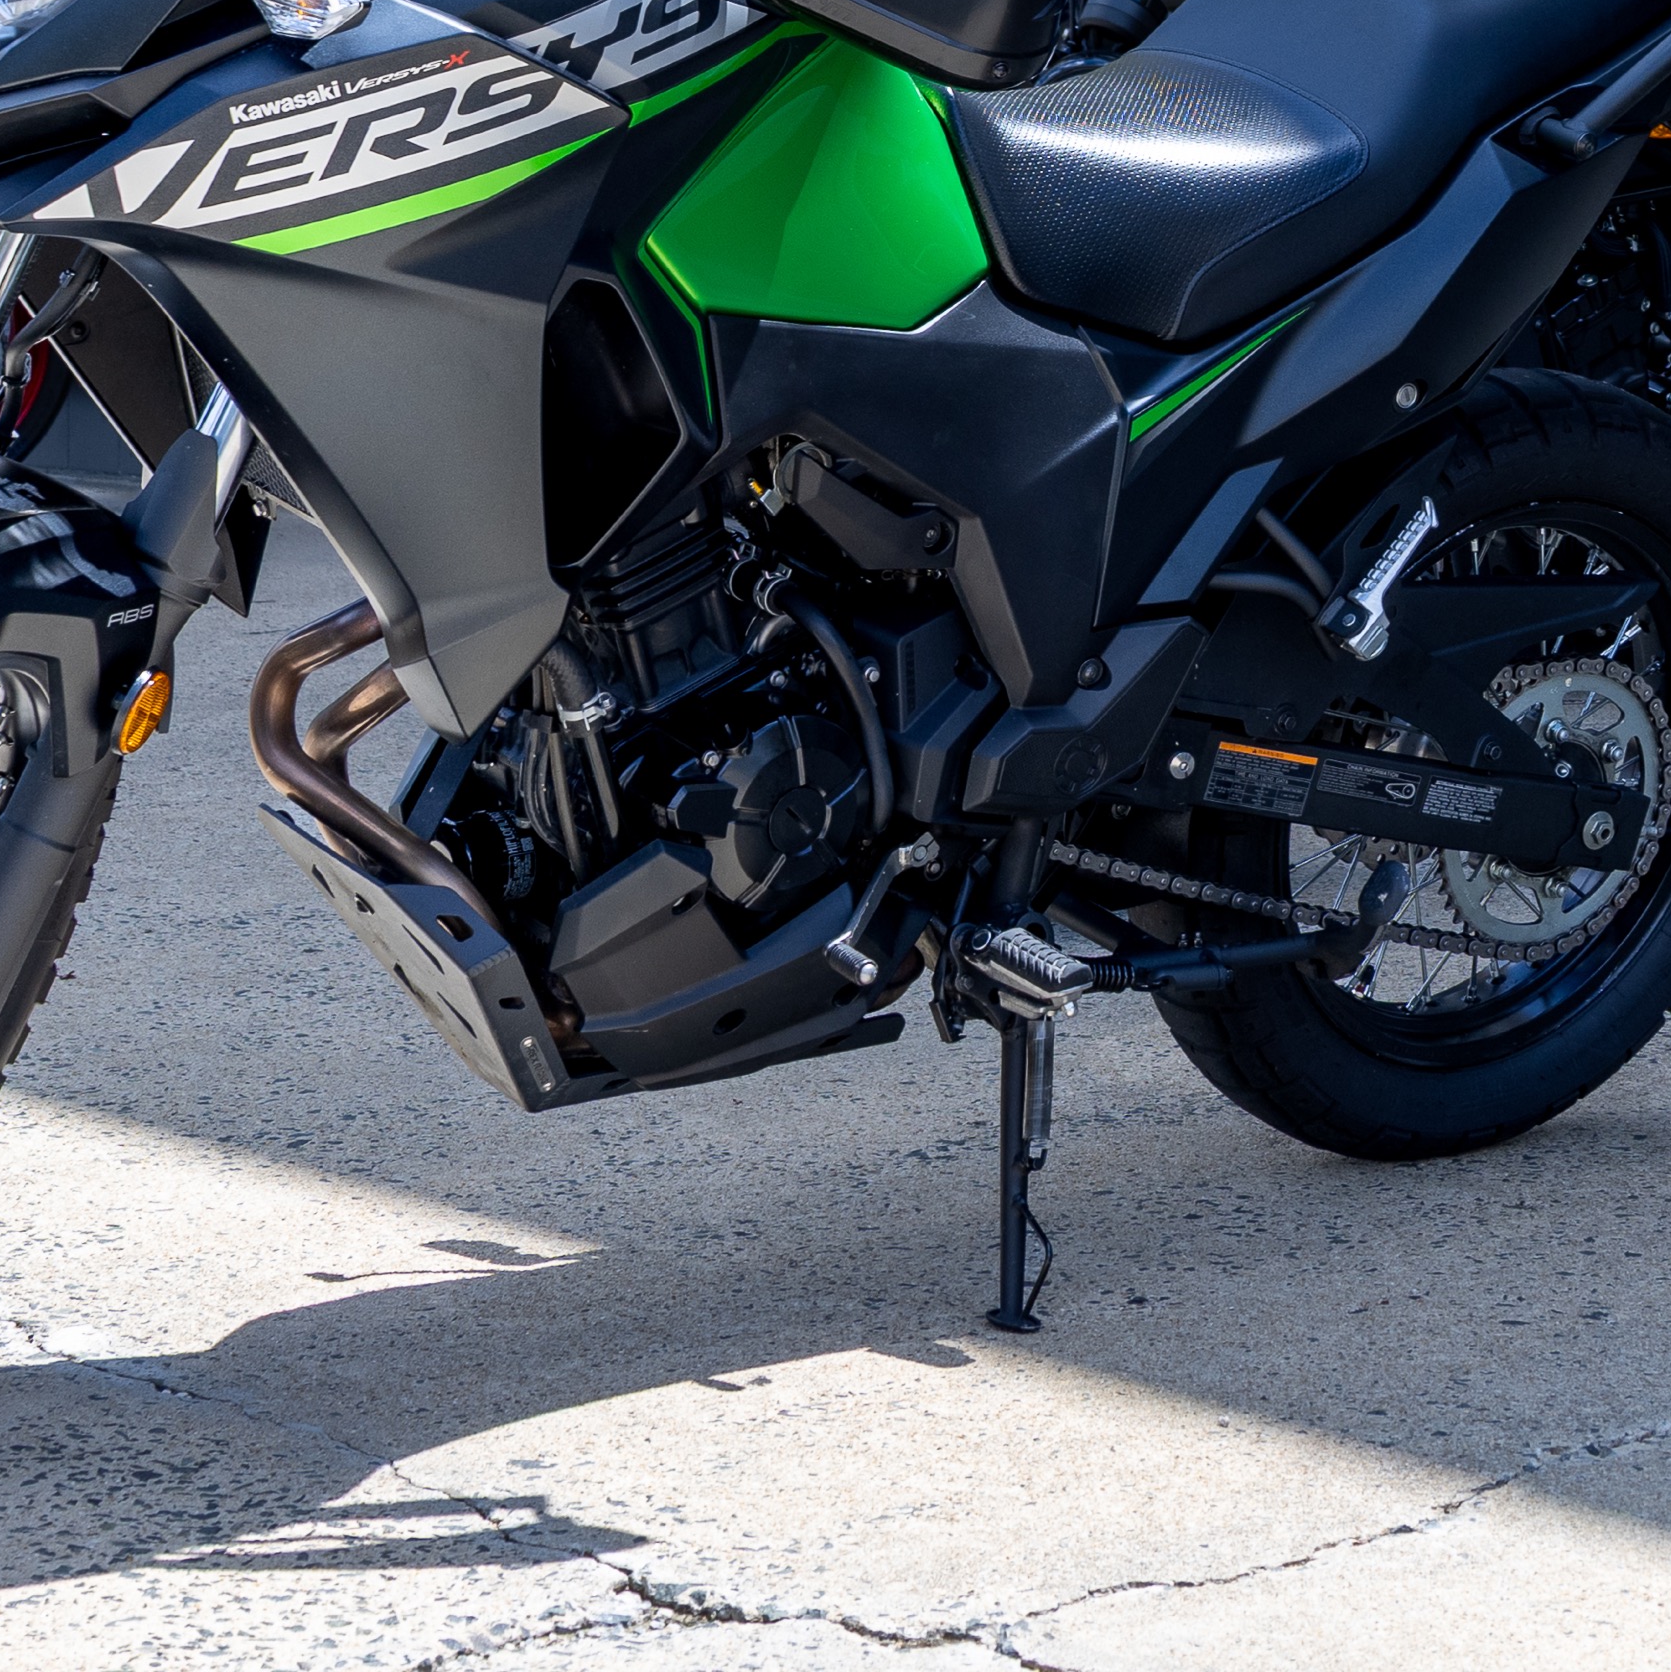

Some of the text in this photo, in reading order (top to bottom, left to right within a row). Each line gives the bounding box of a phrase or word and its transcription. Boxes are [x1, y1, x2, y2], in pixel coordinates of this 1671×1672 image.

[228, 50, 471, 125] Kawasaki VERSYS-X
[107, 603, 155, 628] ABS
